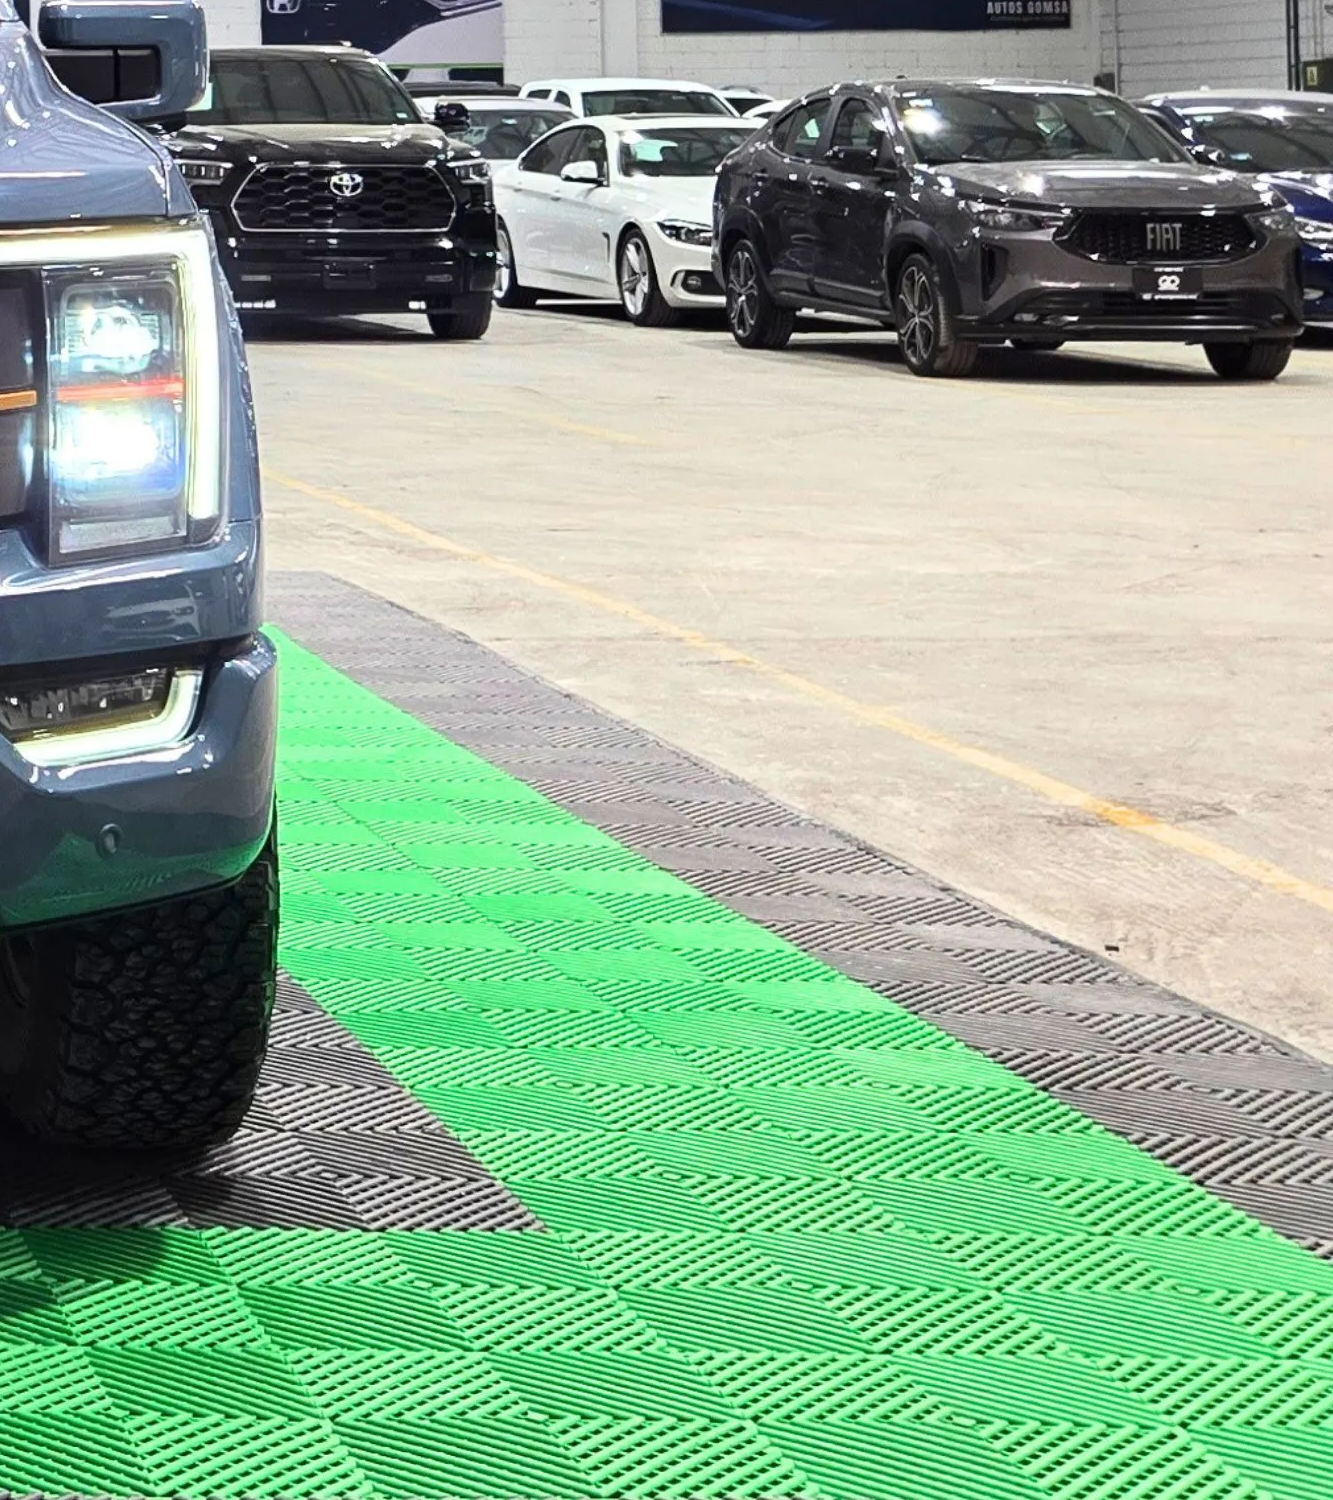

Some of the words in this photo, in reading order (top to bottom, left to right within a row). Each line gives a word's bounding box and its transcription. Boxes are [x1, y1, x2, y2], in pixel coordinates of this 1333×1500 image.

[986, 1, 1023, 14] AUTOS
[1027, 1, 1068, 14] GOMSA
[1146, 223, 1183, 251] FIAT
